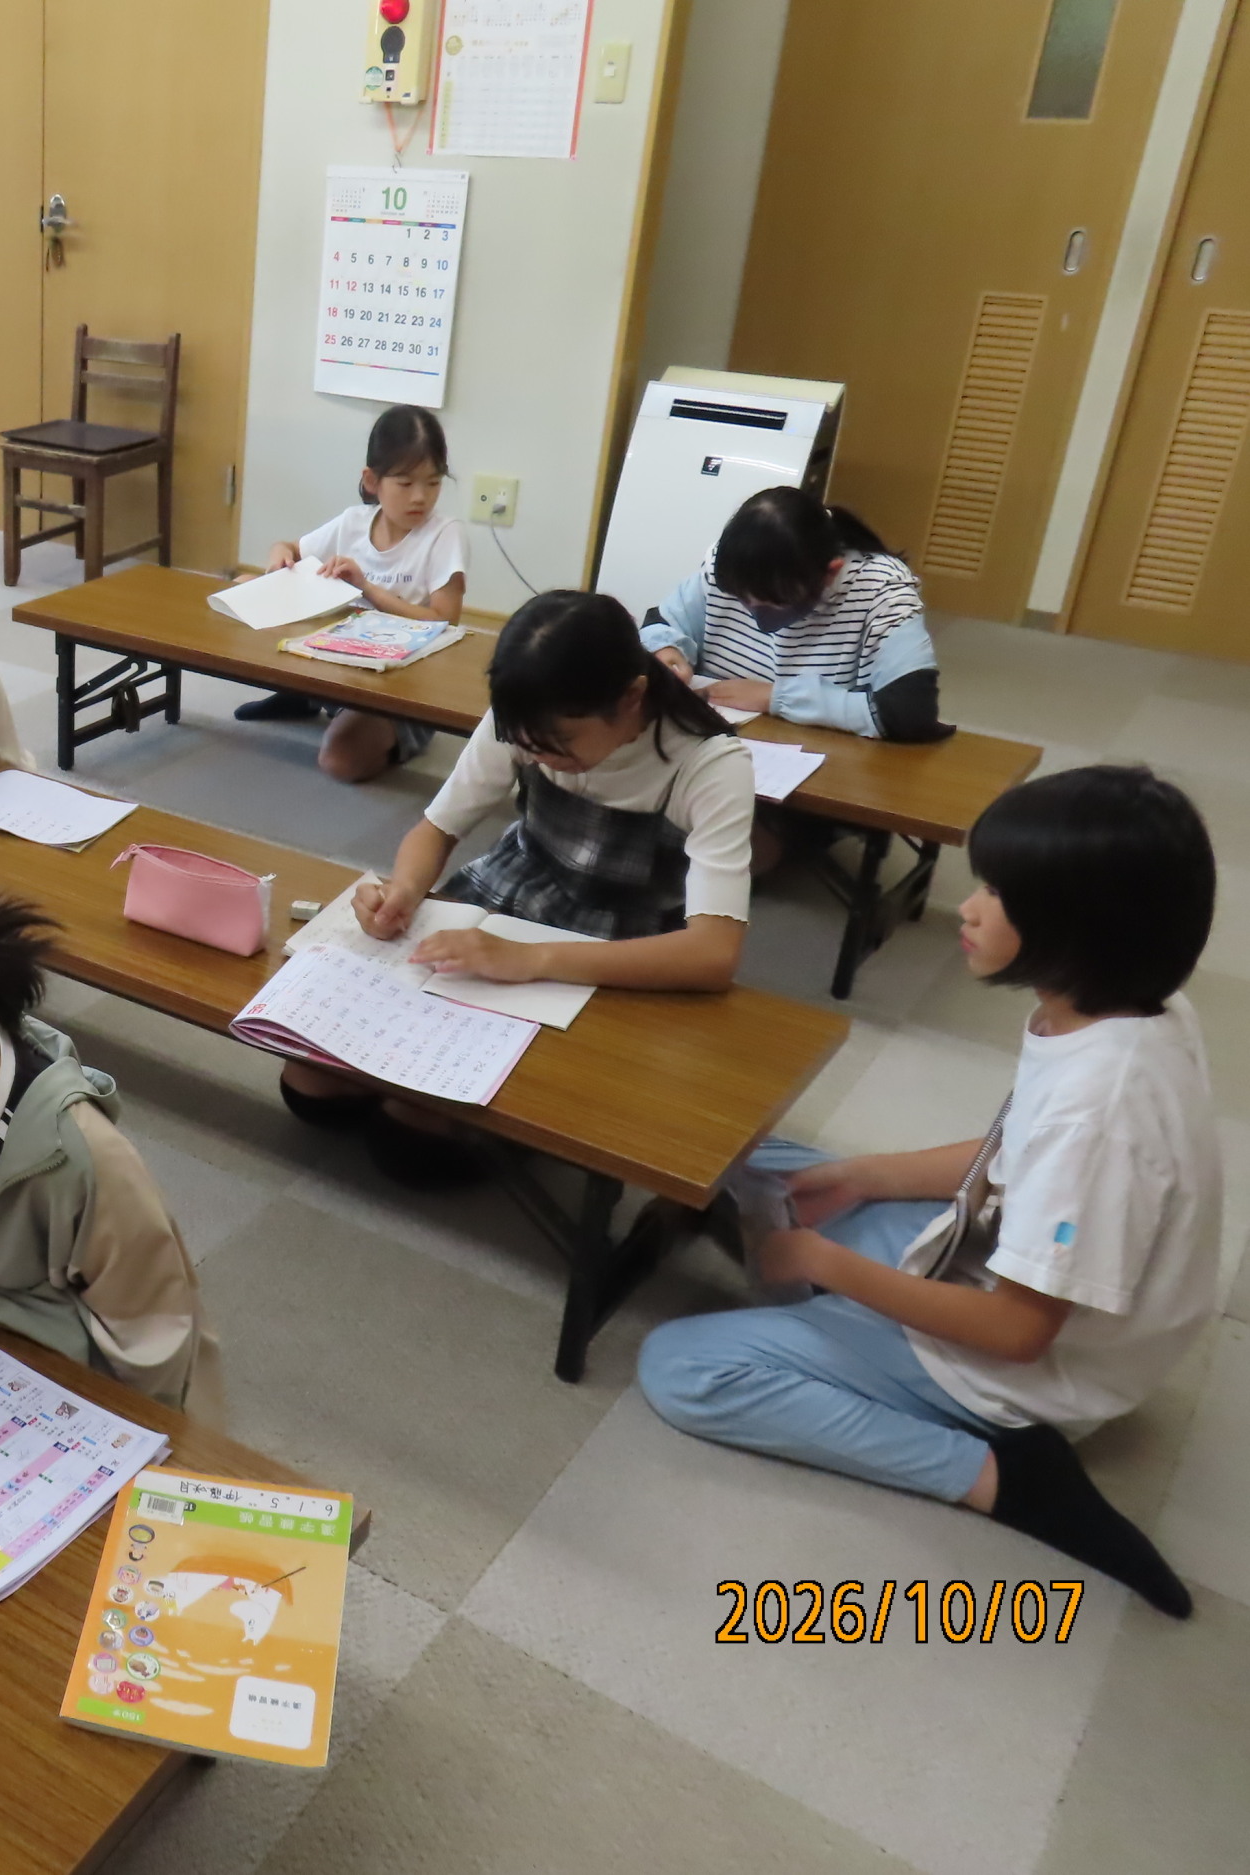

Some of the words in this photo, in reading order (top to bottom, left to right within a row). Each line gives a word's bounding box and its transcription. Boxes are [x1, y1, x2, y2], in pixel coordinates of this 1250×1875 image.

[382, 187, 407, 210] 10
[424, 229, 430, 240] 2
[442, 230, 449, 241] 3
[334, 251, 340, 261] 4
[351, 253, 357, 263] 5
[368, 254, 374, 264] 6
[386, 256, 392, 266] 7
[403, 257, 409, 267] 8
[421, 258, 427, 268] 9
[437, 260, 448, 270] 10
[330, 279, 339, 289] 11
[346, 281, 357, 291] 12
[363, 282, 374, 293] 13
[380, 284, 391, 294] 14
[398, 285, 409, 296] 15
[416, 287, 427, 298] 16
[433, 288, 445, 299] 17
[328, 307, 337, 317] 18
[344, 308, 355, 319] 19
[360, 310, 372, 321] 20
[378, 312, 389, 322] 21
[395, 313, 407, 324] 22
[412, 315, 424, 326] 23
[429, 317, 442, 328] 24
[325, 334, 336, 345] 25
[341, 336, 353, 346] 26
[358, 338, 370, 348] 27
[375, 340, 387, 350] 28
[392, 342, 404, 353] 29
[409, 344, 421, 354] 30
[427, 346, 439, 356] 31
